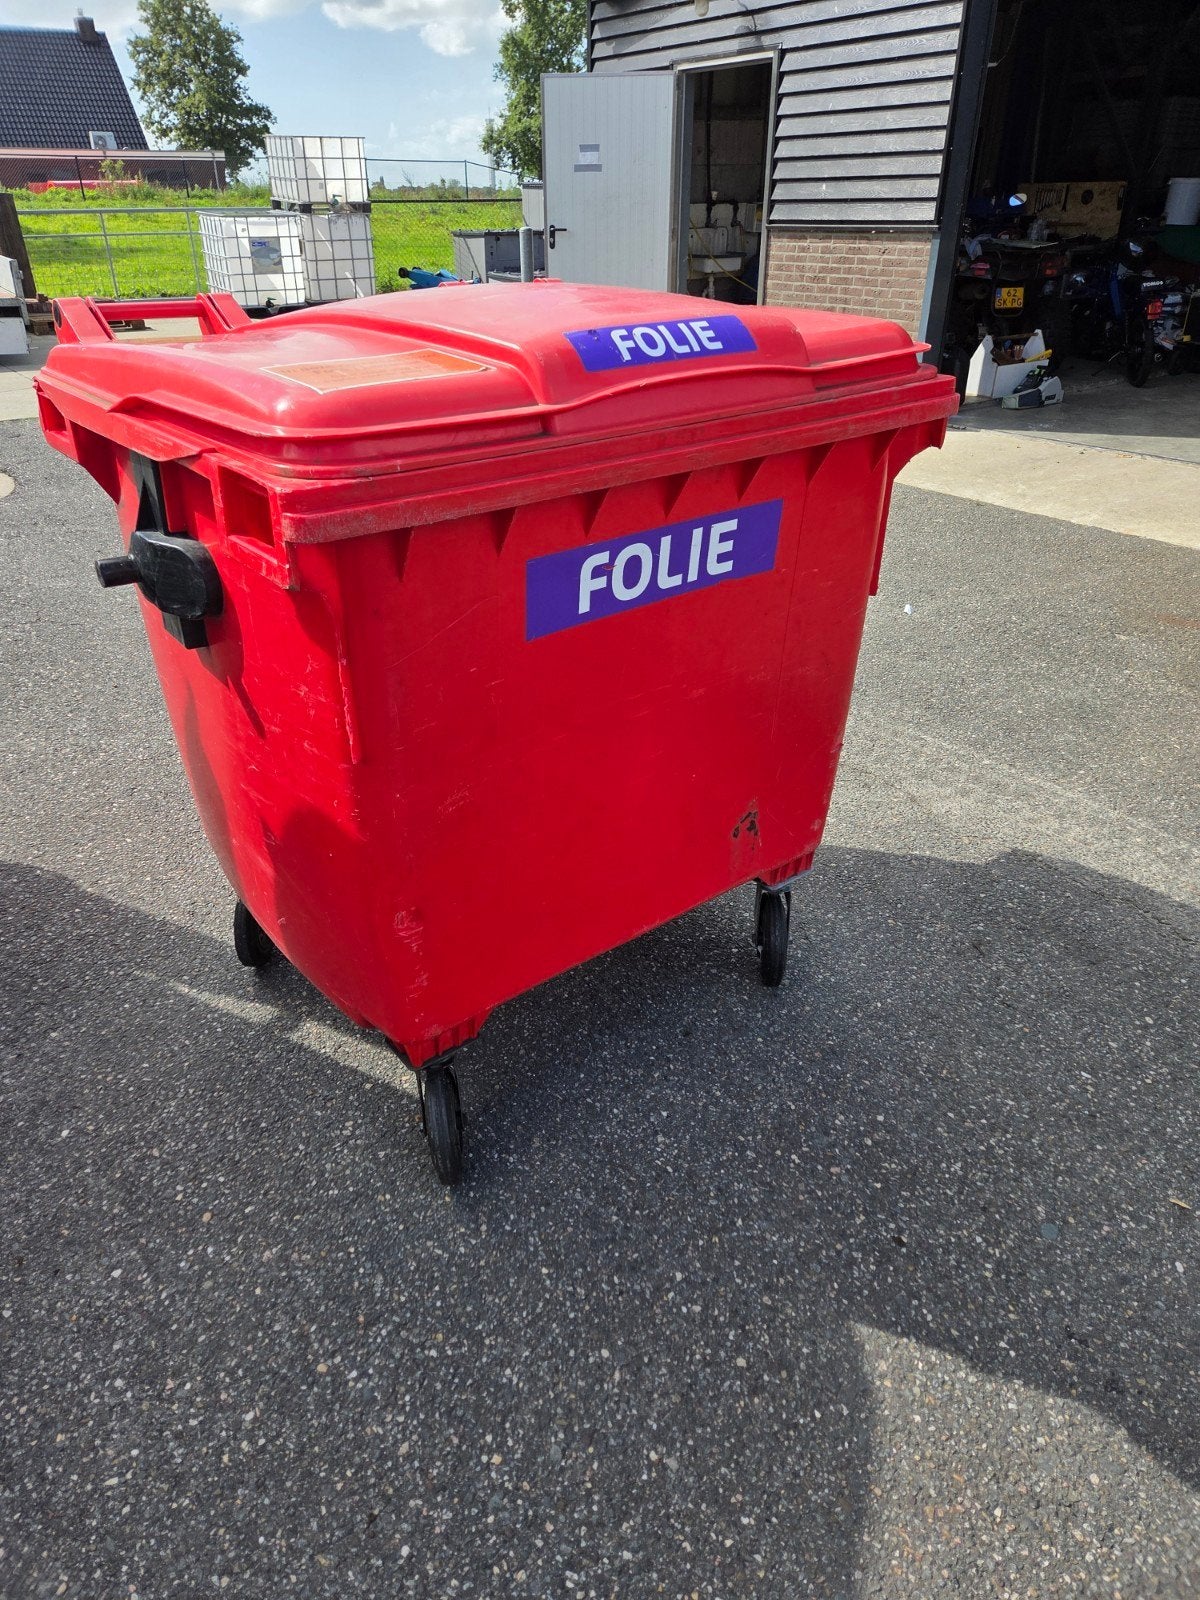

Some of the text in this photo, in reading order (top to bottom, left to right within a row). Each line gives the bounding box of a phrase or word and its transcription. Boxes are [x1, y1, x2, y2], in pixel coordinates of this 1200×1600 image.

[1006, 288, 1018, 297] 62
[610, 320, 723, 361] FOLIE
[578, 518, 739, 615] FOLIE
